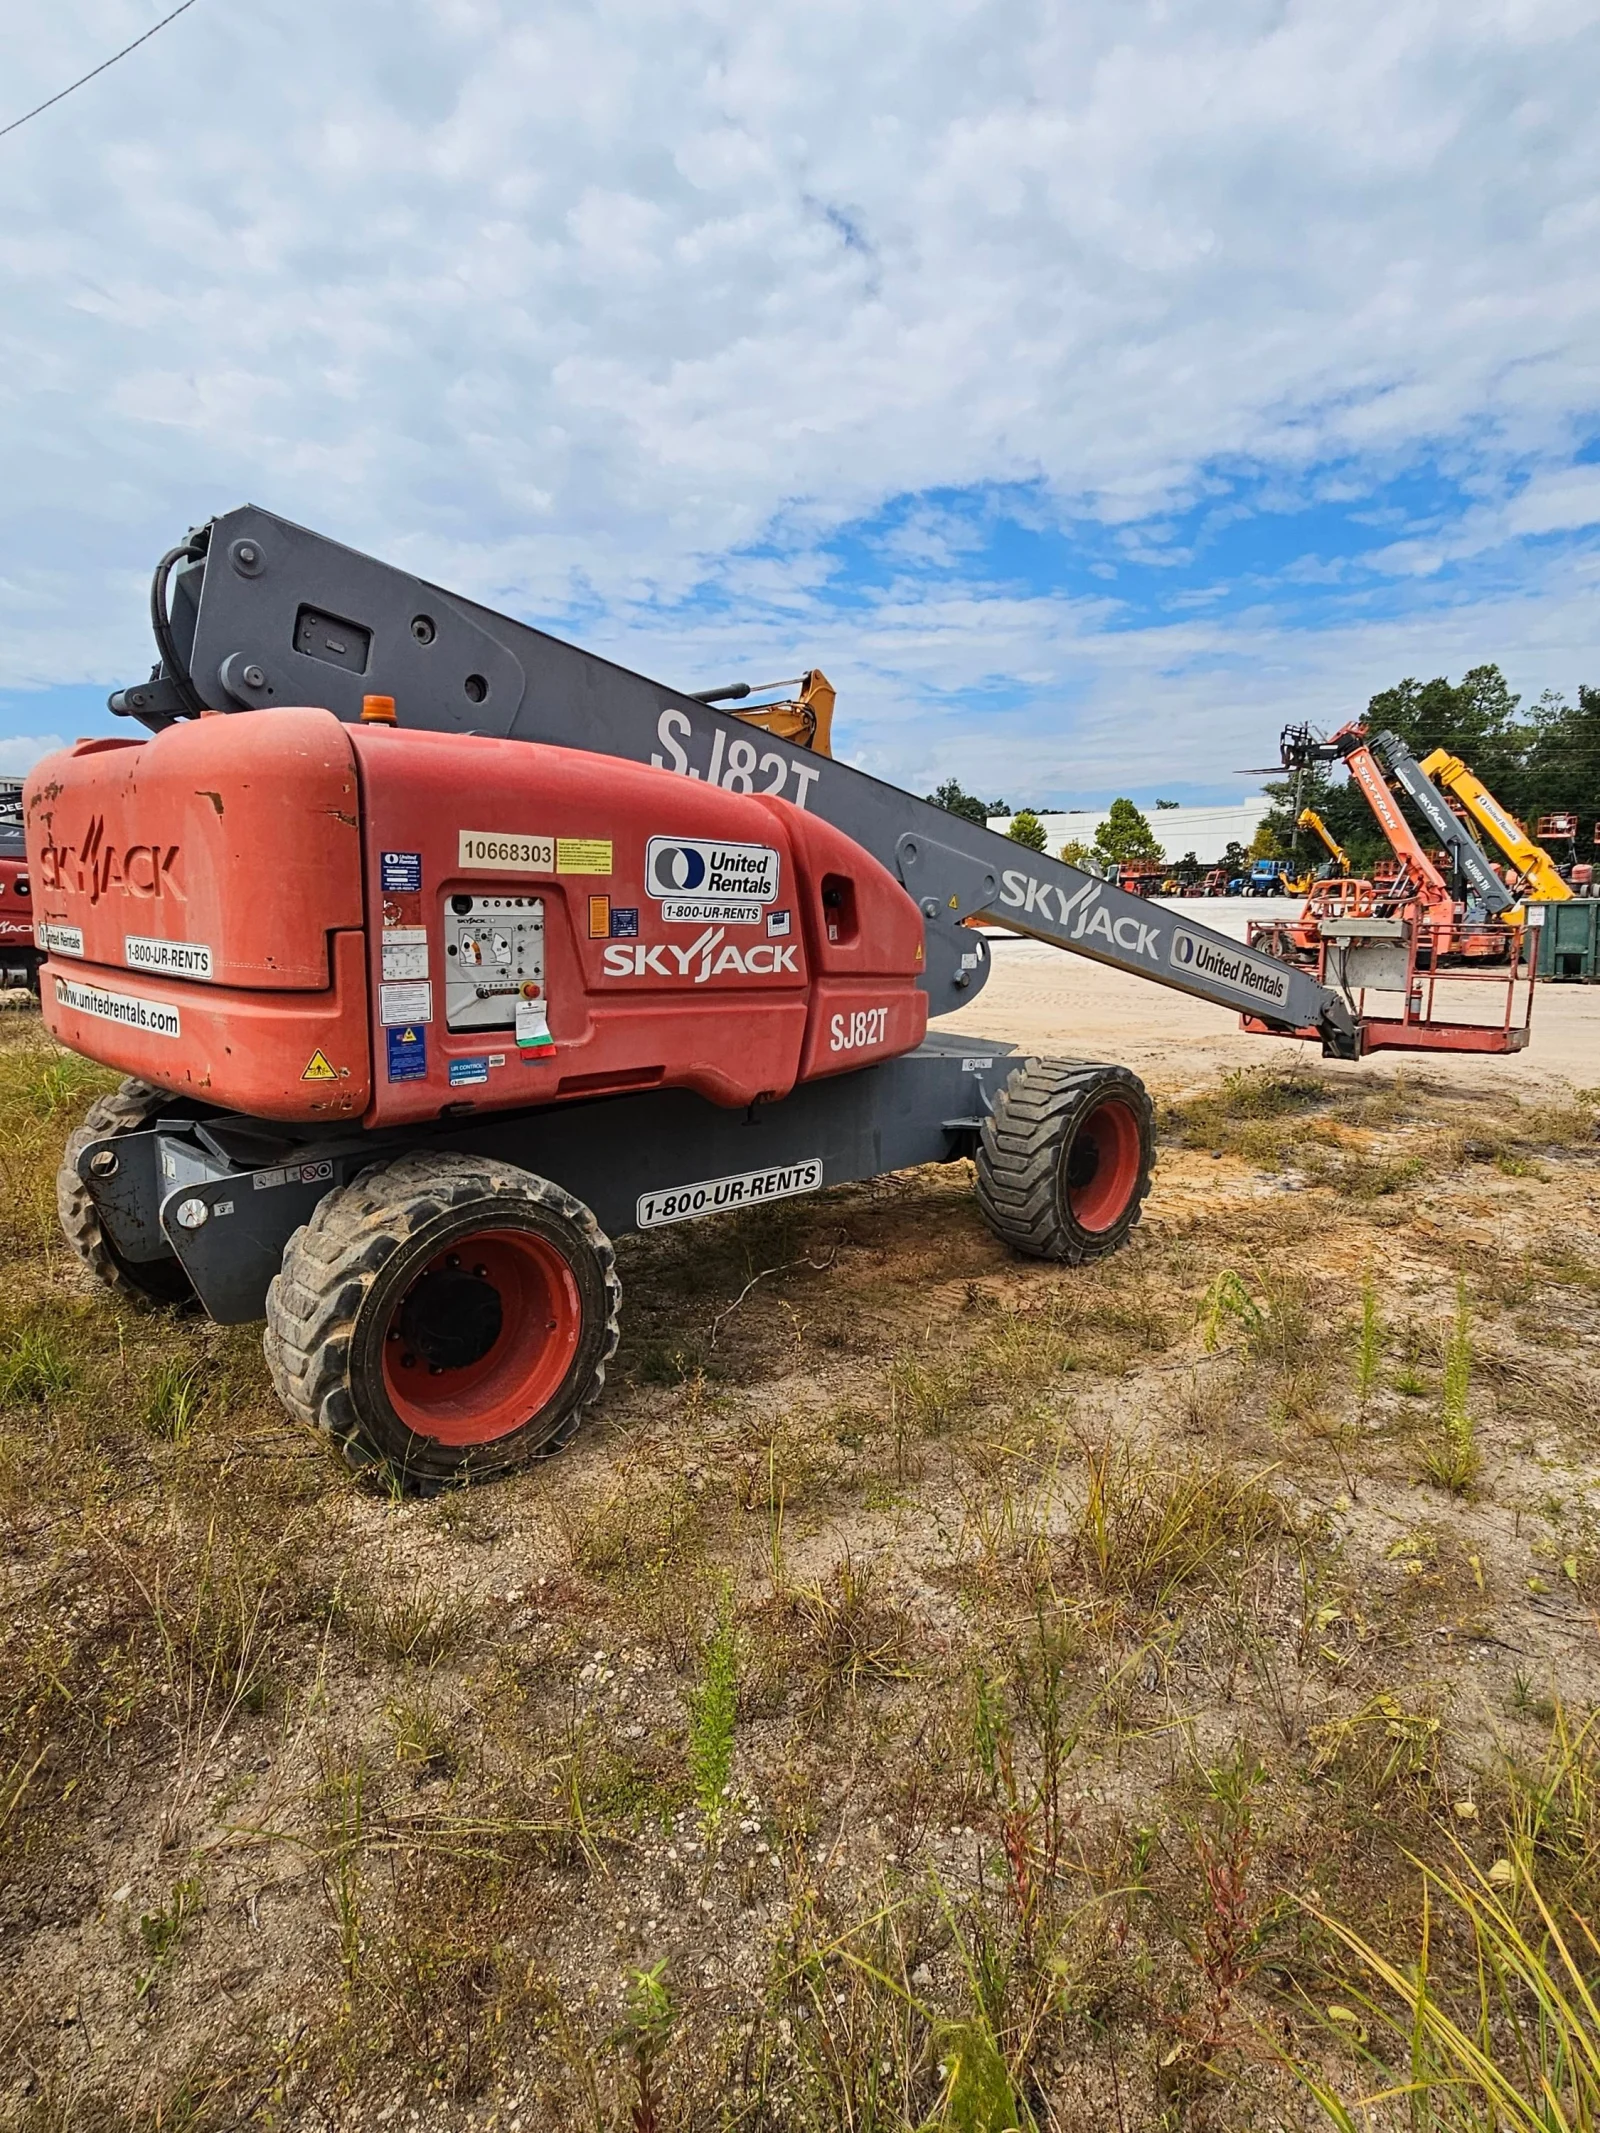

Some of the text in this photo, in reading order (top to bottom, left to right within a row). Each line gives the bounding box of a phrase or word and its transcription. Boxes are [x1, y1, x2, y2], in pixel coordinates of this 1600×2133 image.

[651, 709, 820, 809] SJ82T
[1359, 766, 1398, 830] SKYTRAK
[1419, 793, 1448, 832] SKYJACK
[1485, 804, 1503, 823] United
[40, 814, 188, 906] SKYJACK
[464, 840, 552, 863] 10668303
[710, 851, 769, 874] United
[708, 872, 771, 894] Rentals
[666, 905, 759, 920] 1-800-UR-RENTS
[1000, 869, 1160, 960] SKYJACK
[128, 944, 209, 971] 1-800-UR-RENTS
[603, 926, 799, 983] SKYJACK
[1195, 944, 1284, 998] United Rentals
[56, 985, 178, 1034] www.unitedrentals.com
[830, 1007, 888, 1052] SJ82T
[645, 1165, 816, 1221] 1-800-UR-RENTS
